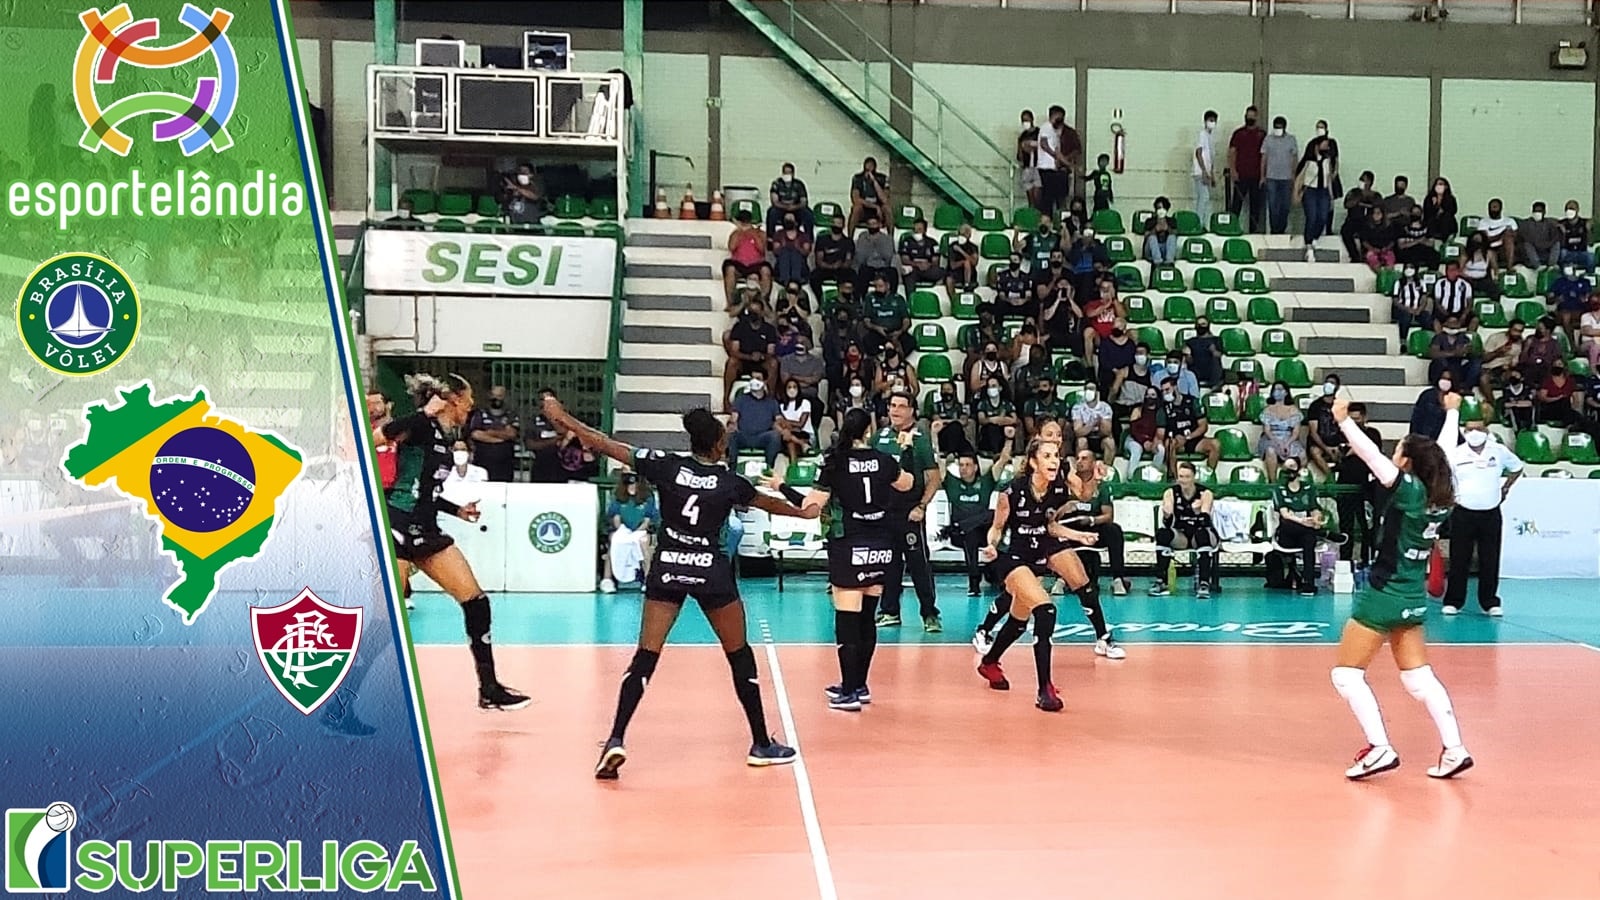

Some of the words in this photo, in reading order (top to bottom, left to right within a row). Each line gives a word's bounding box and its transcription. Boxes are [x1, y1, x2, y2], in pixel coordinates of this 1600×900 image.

[421, 241, 564, 286] SESI
[862, 476, 872, 504] 1
[681, 494, 700, 526] 4
[867, 549, 893, 564] BRB
